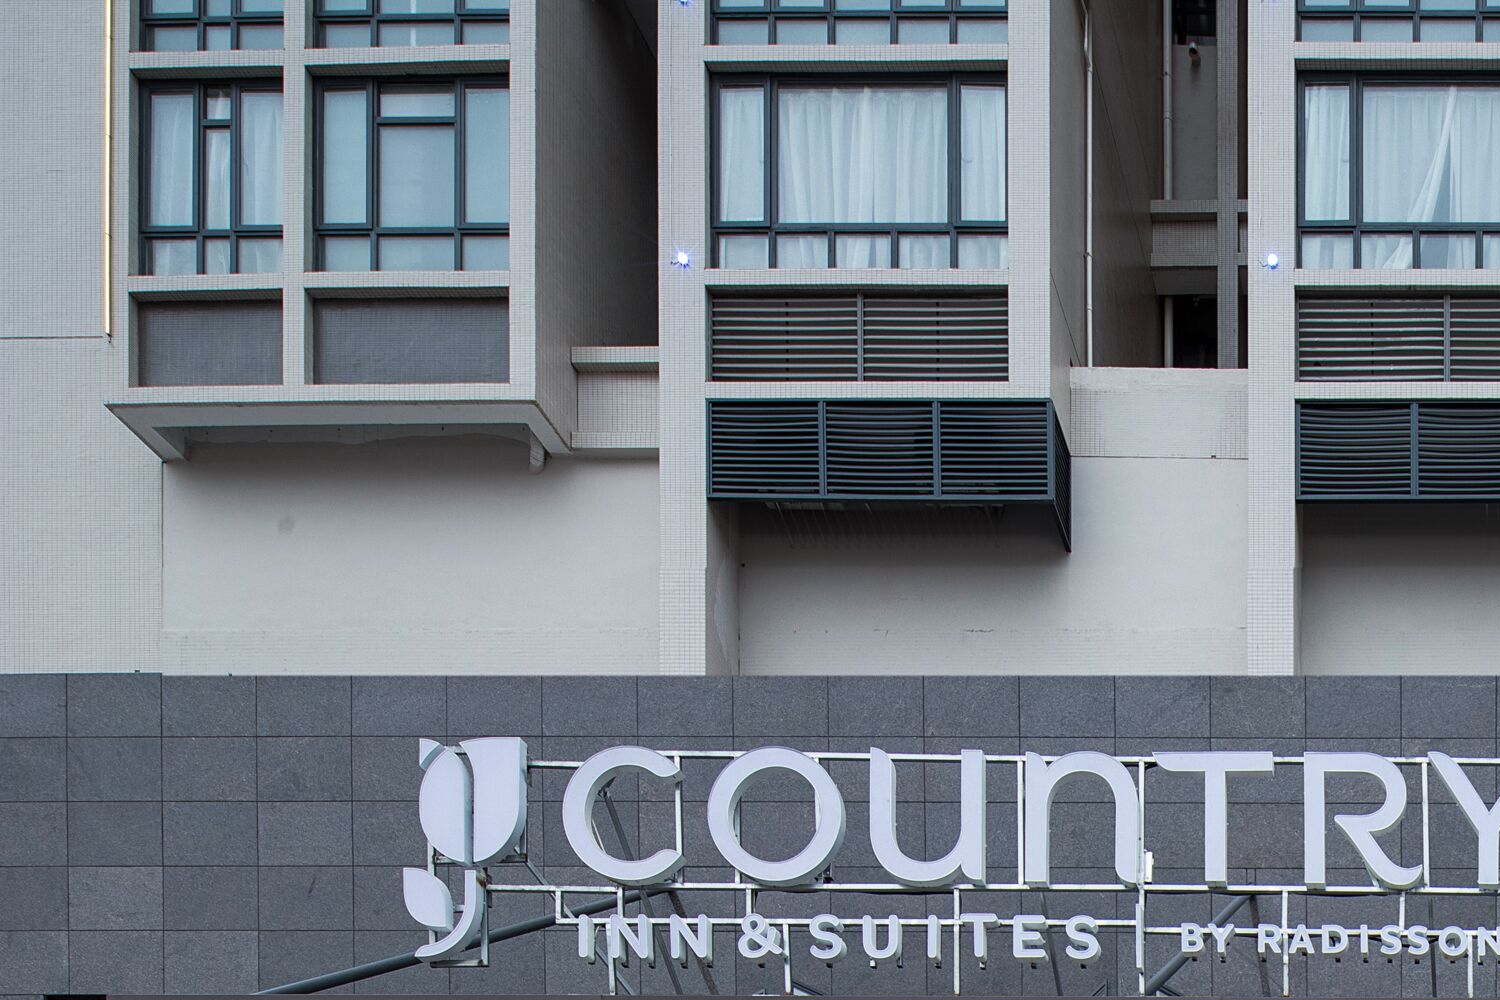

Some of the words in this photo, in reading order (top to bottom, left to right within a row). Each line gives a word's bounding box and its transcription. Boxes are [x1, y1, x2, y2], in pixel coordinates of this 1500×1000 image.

[578, 913, 713, 963] INN
[809, 912, 1101, 963] SUITES
[1180, 922, 1235, 959] BY
